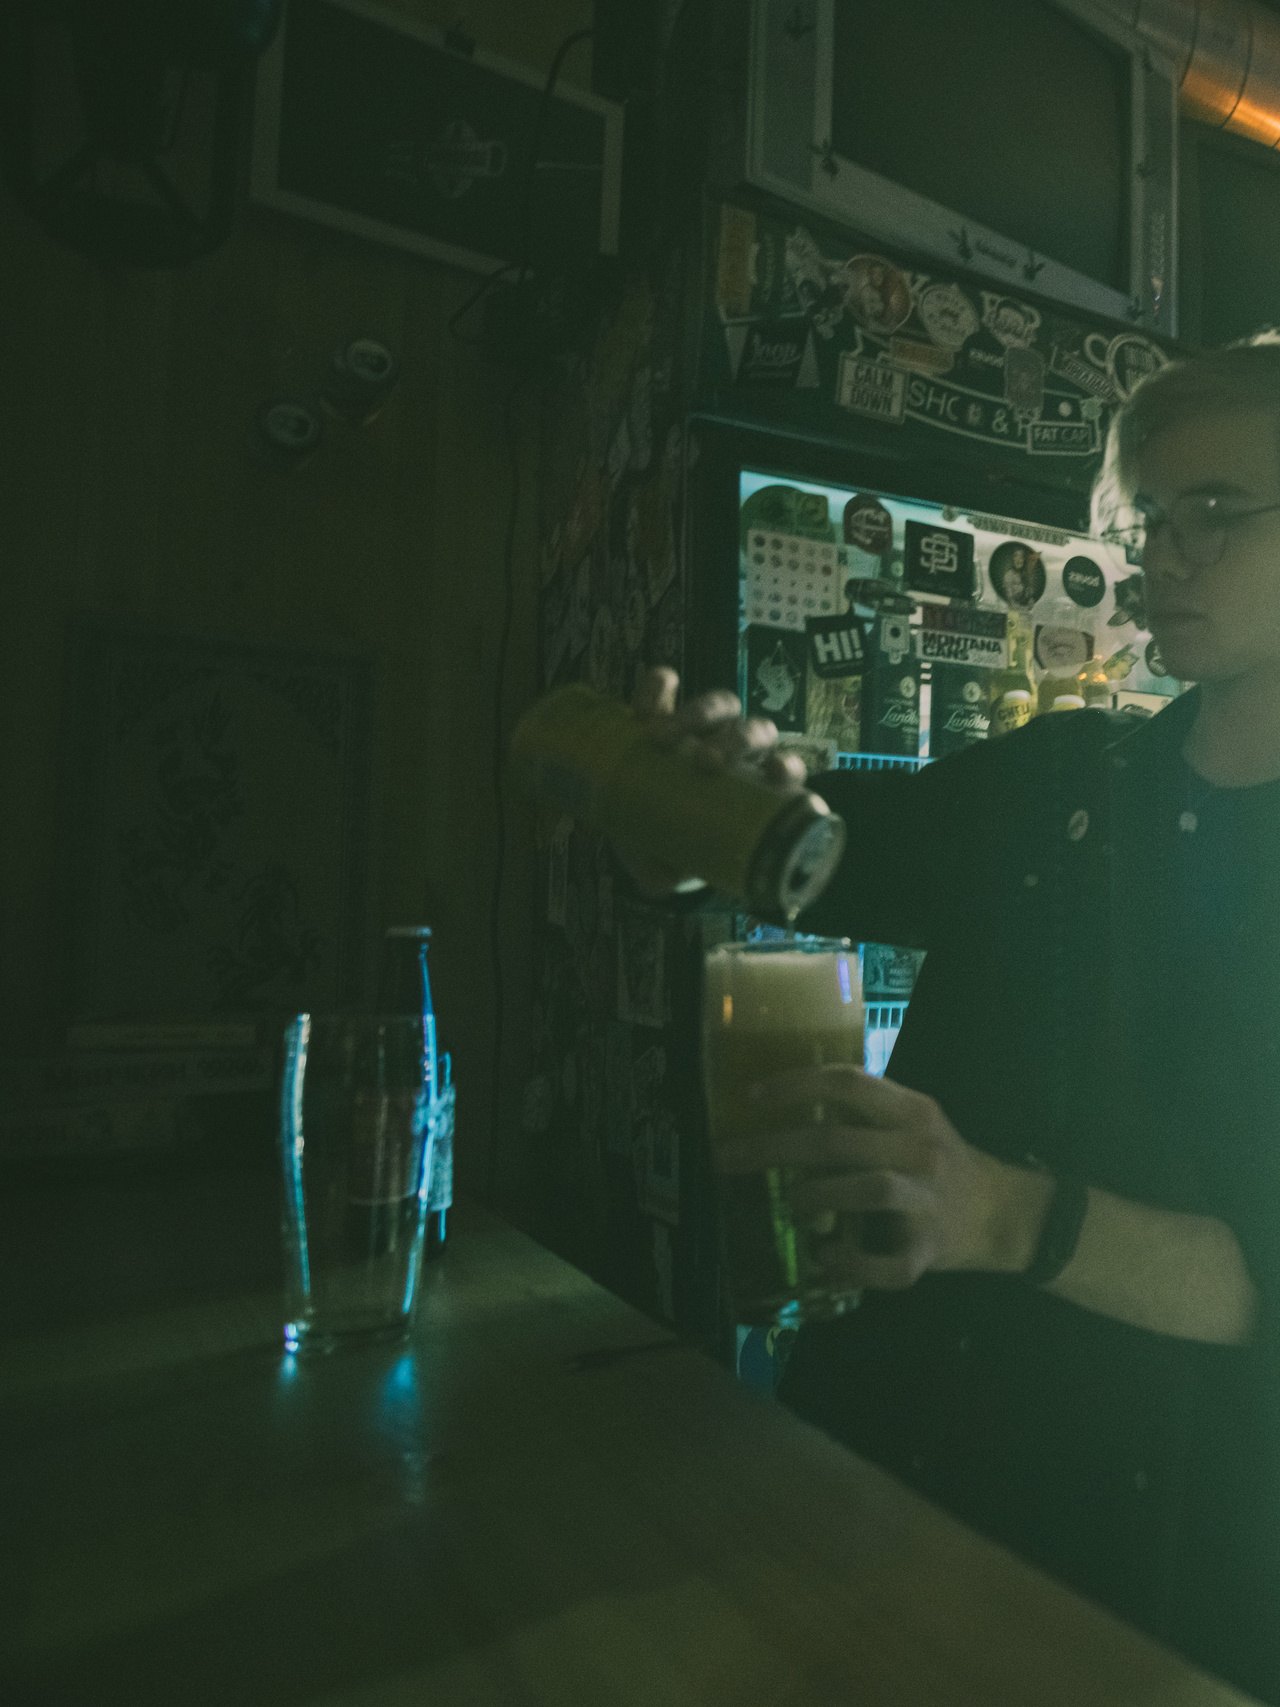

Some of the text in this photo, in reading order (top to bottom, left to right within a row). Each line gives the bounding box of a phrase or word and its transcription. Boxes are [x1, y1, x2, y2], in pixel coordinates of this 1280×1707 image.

[1033, 427, 1059, 442] FAT
[813, 627, 864, 664] HI!
[922, 632, 1002, 654] MONTANA
[922, 644, 969, 661] CANS
